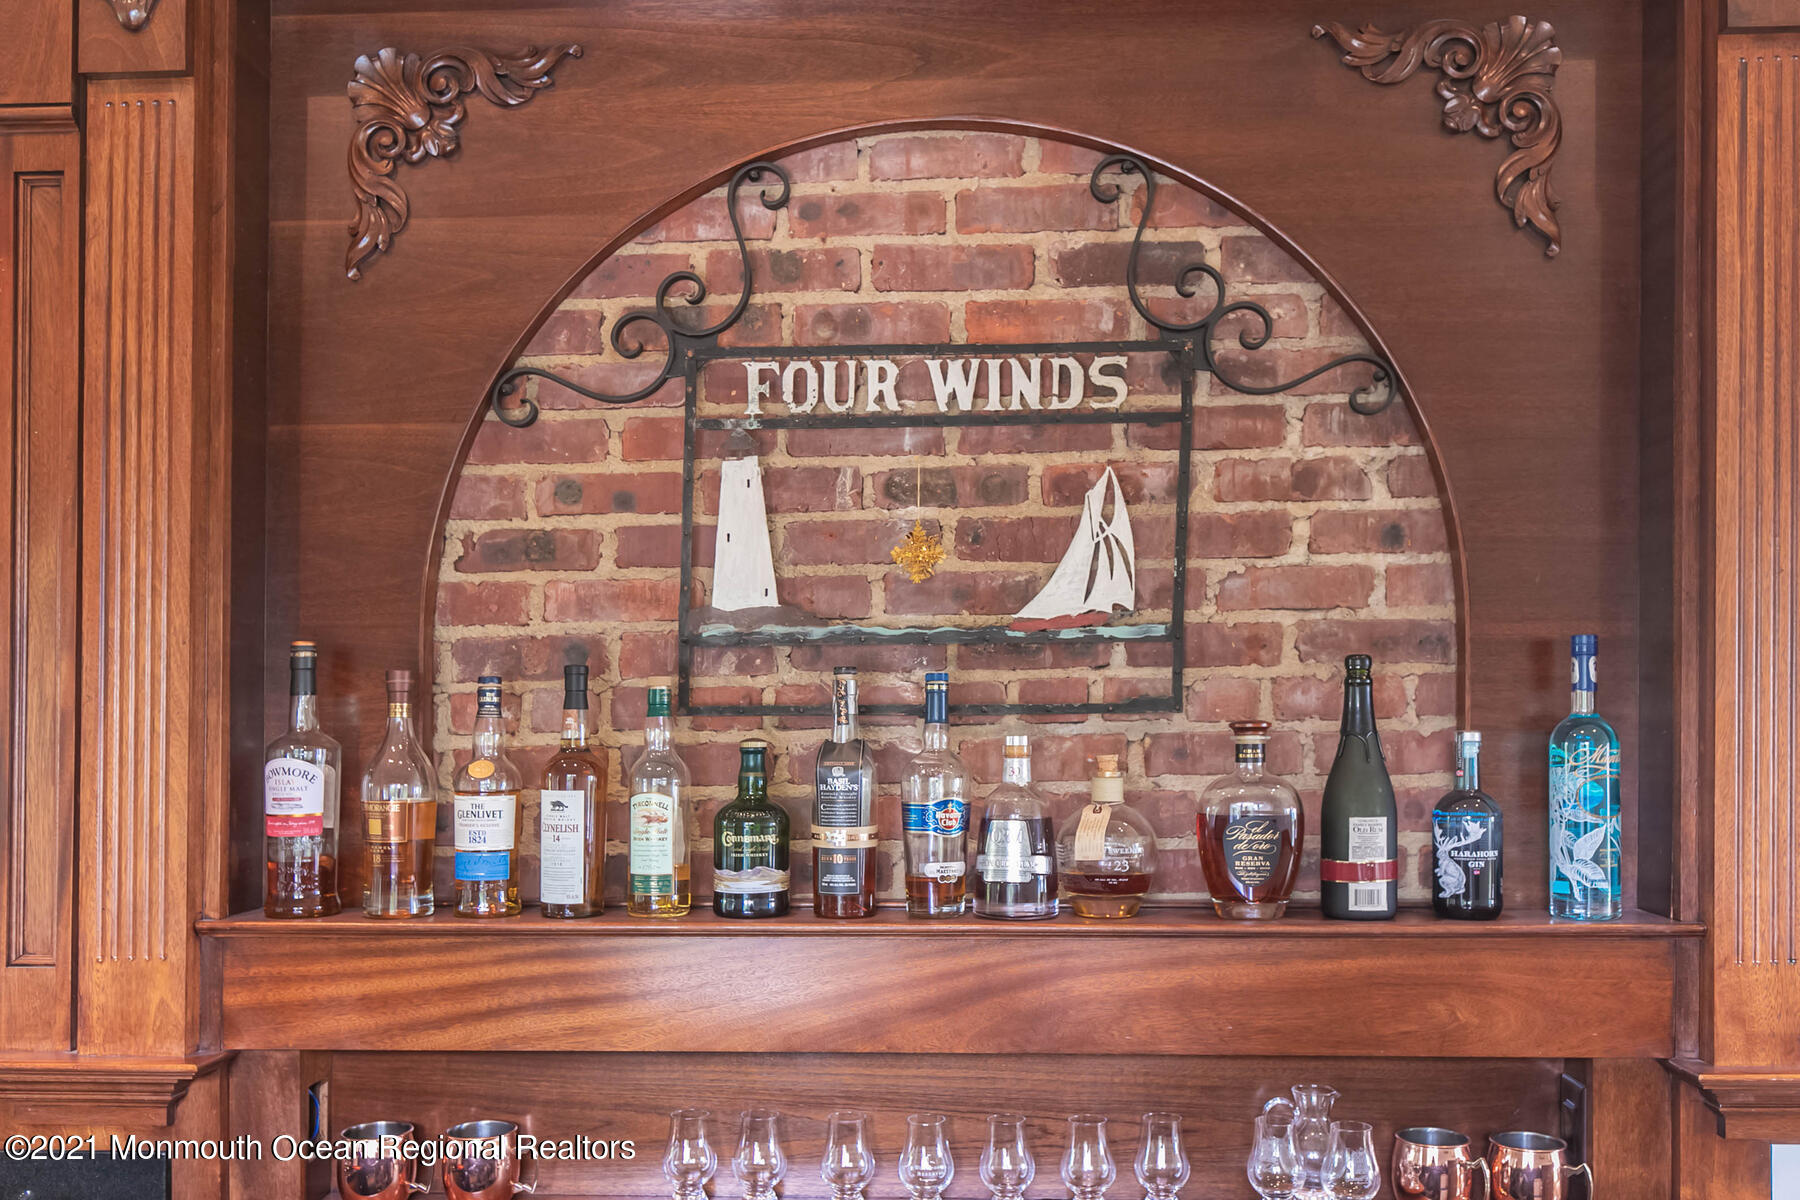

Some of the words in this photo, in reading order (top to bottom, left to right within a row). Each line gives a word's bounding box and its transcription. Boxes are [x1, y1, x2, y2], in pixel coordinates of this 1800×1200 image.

[742, 359, 900, 416] FOUR
[924, 355, 1129, 412] WINDS
[457, 810, 503, 819] GLENLIVET
[469, 836, 487, 844] 1824
[552, 834, 560, 842] 14
[373, 854, 381, 863] 18
[833, 854, 844, 864] 10
[1114, 860, 1129, 872] 23
